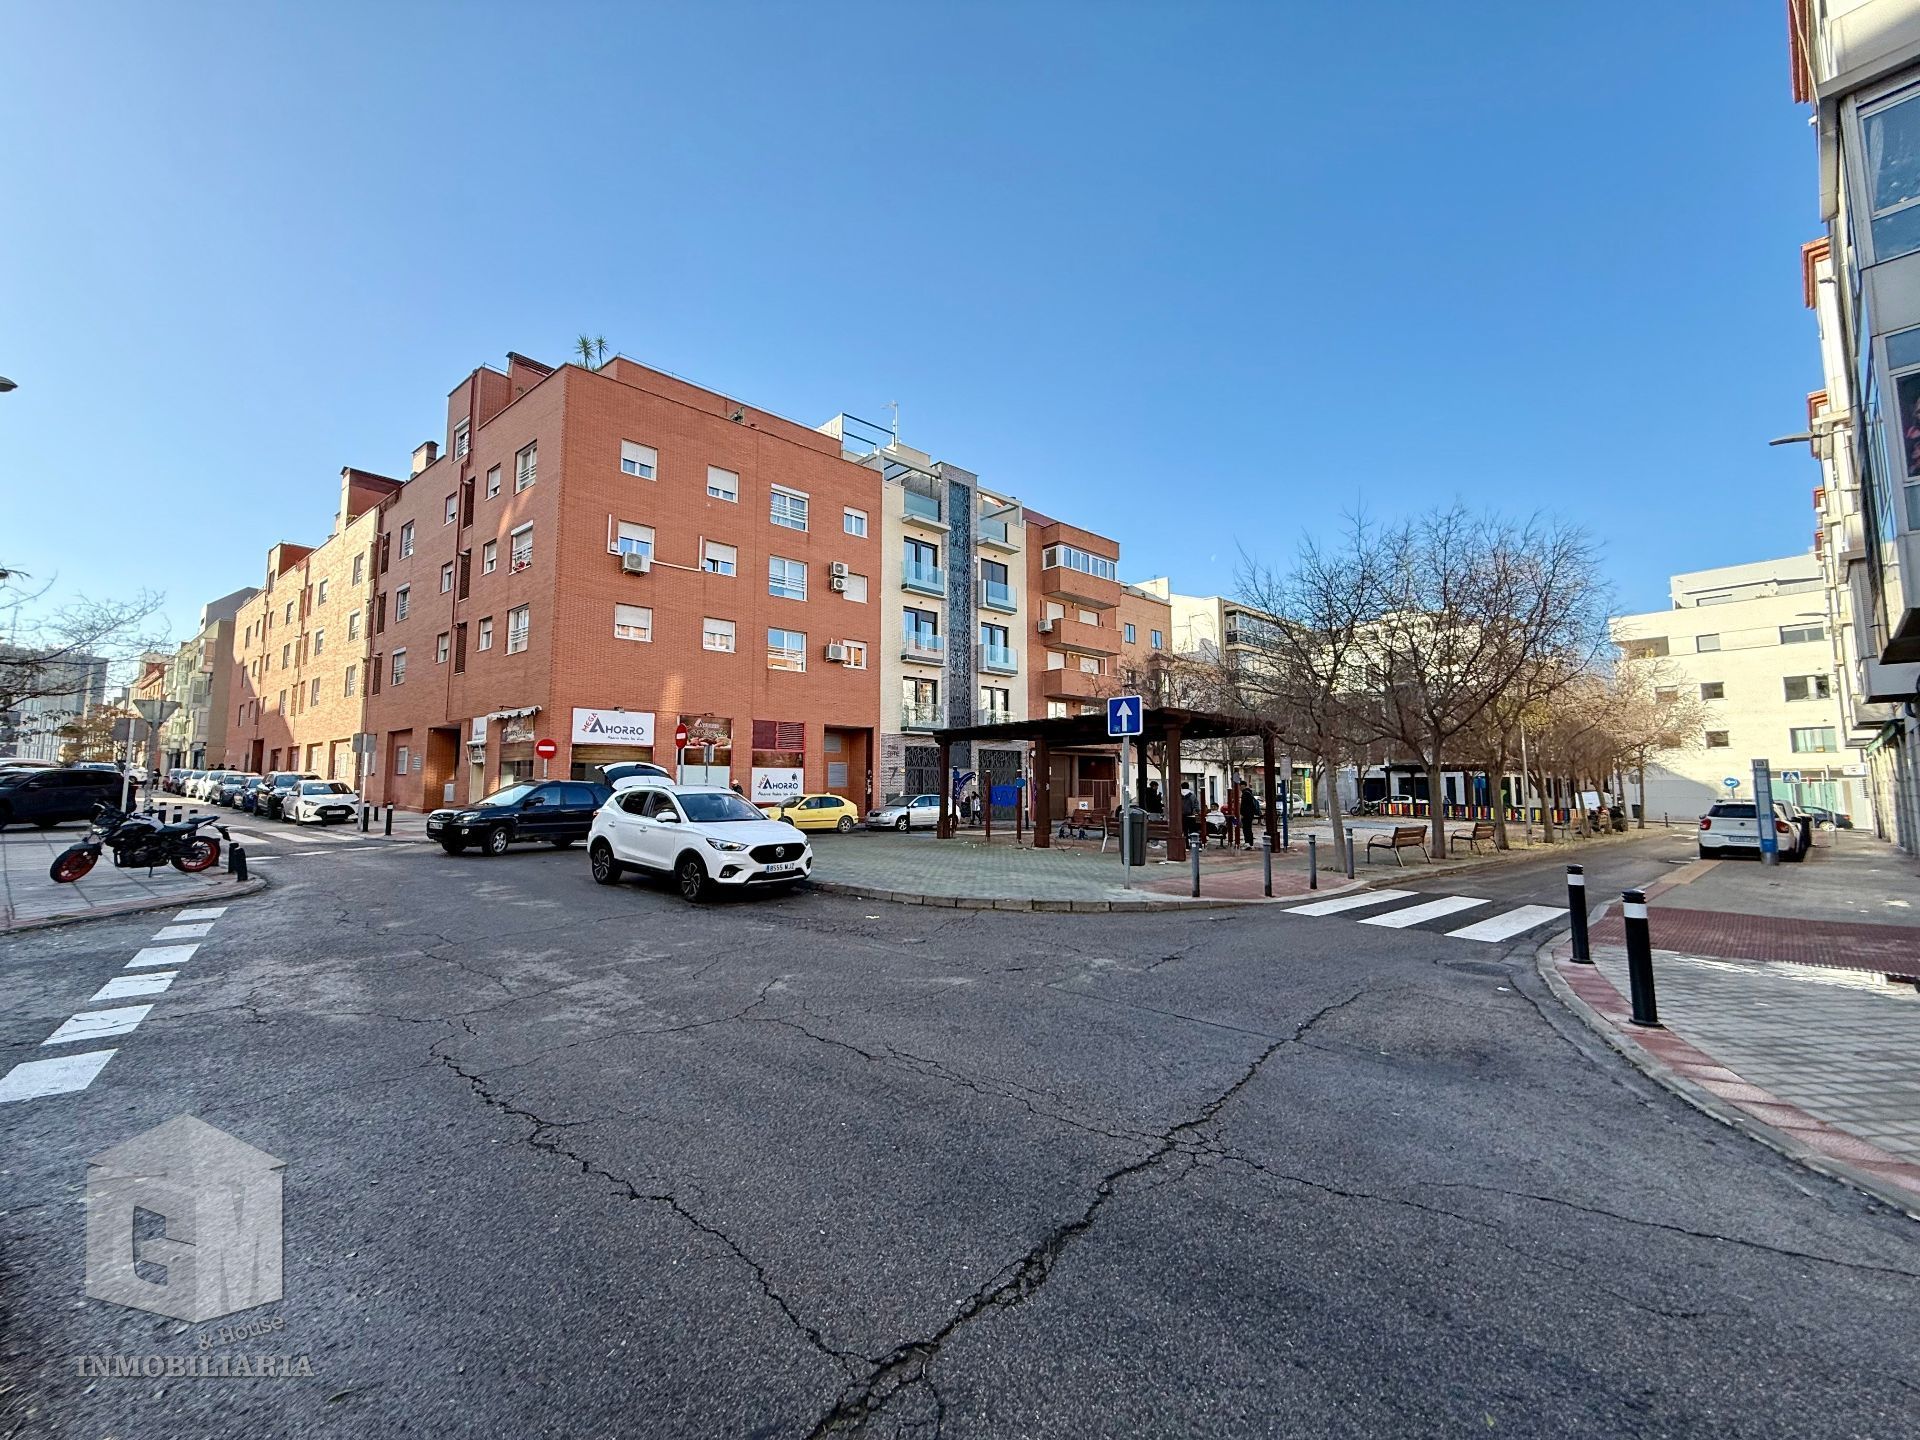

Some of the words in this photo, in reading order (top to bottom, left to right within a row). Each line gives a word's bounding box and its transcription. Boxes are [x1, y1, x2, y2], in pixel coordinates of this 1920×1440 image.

[582, 713, 597, 732] MEGA
[589, 717, 644, 735] AHORRO
[763, 778, 798, 789] AHORRO
